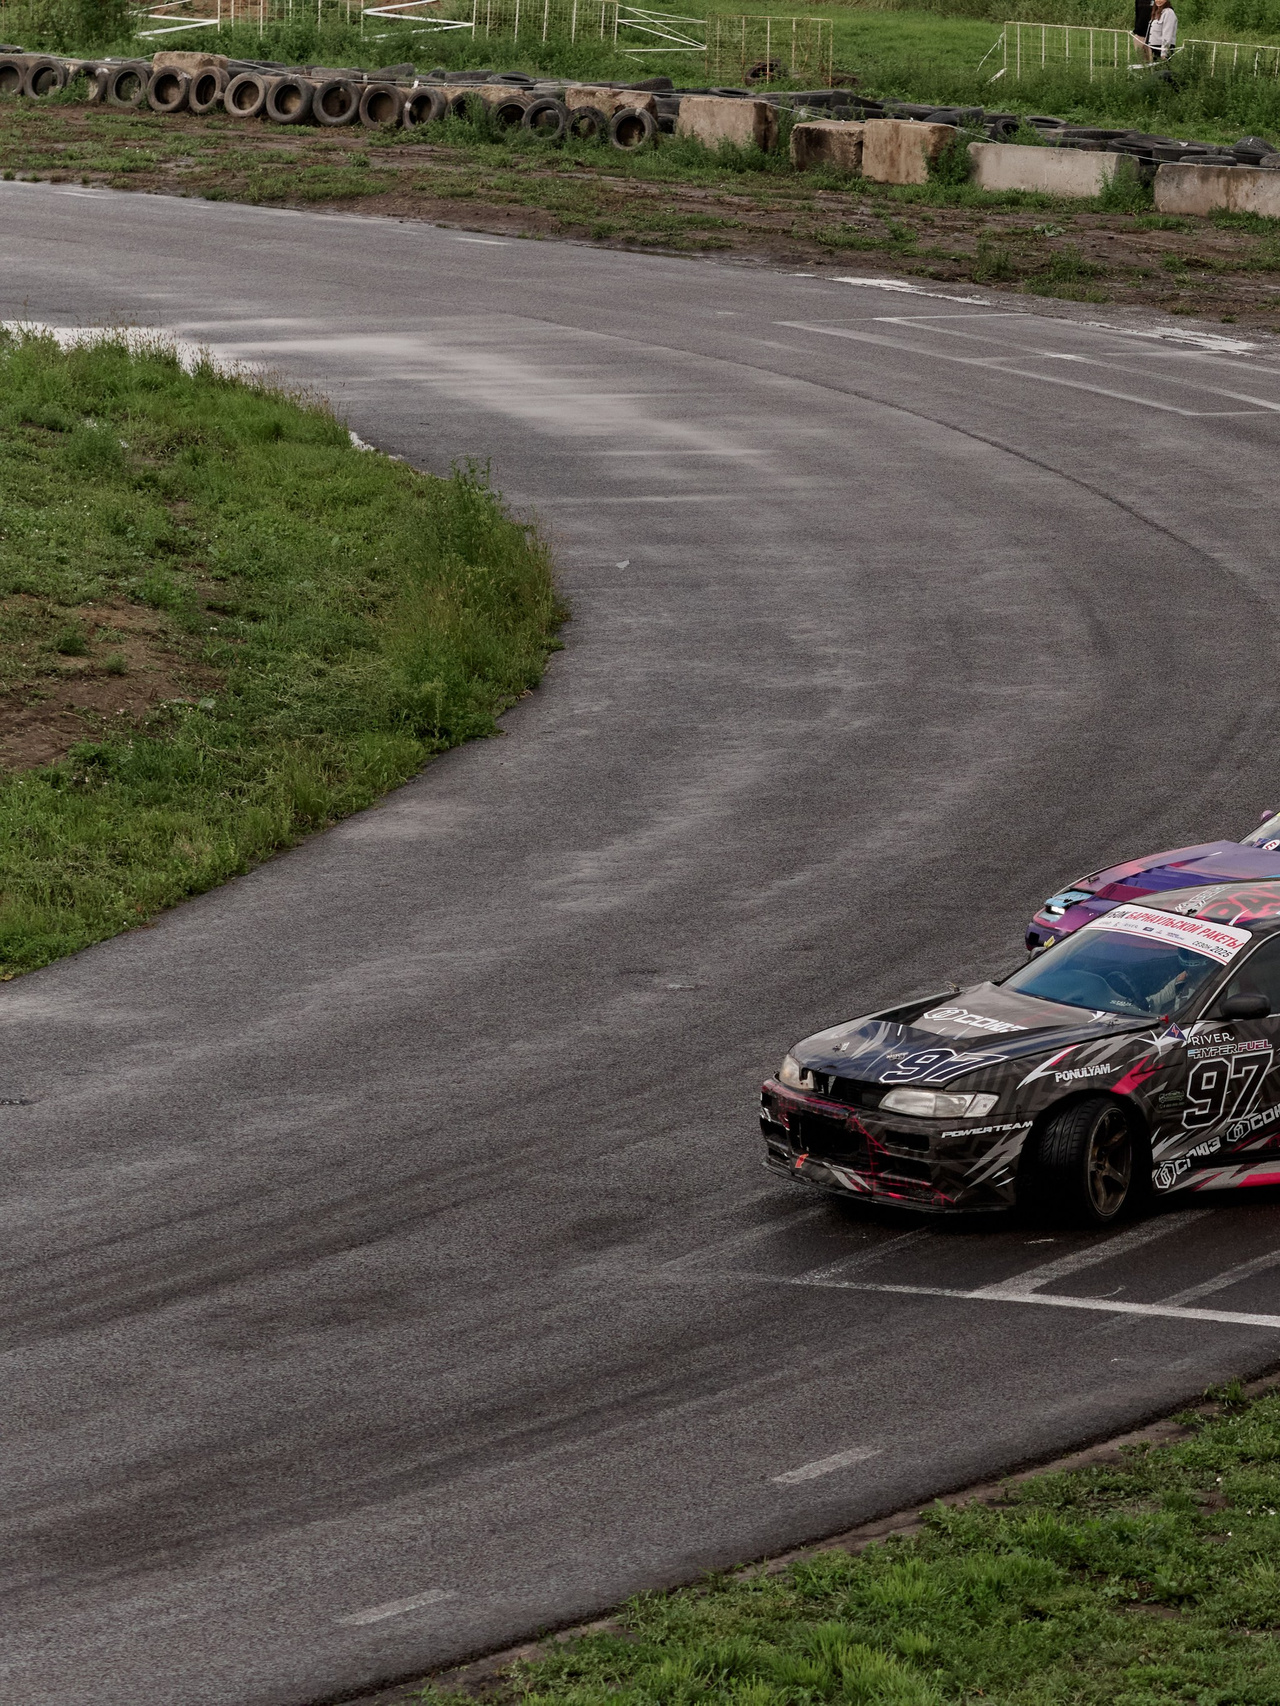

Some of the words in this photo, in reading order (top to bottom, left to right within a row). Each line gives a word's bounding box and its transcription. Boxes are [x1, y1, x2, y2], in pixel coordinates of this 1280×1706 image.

[1198, 928, 1245, 950] РАКЕТЫ
[1210, 945, 1233, 958] 2025
[1190, 1032, 1235, 1046] RIVER
[879, 1048, 1011, 1084] 97
[1055, 1063, 1111, 1083] PONULYAM
[1181, 1049, 1275, 1129] 97
